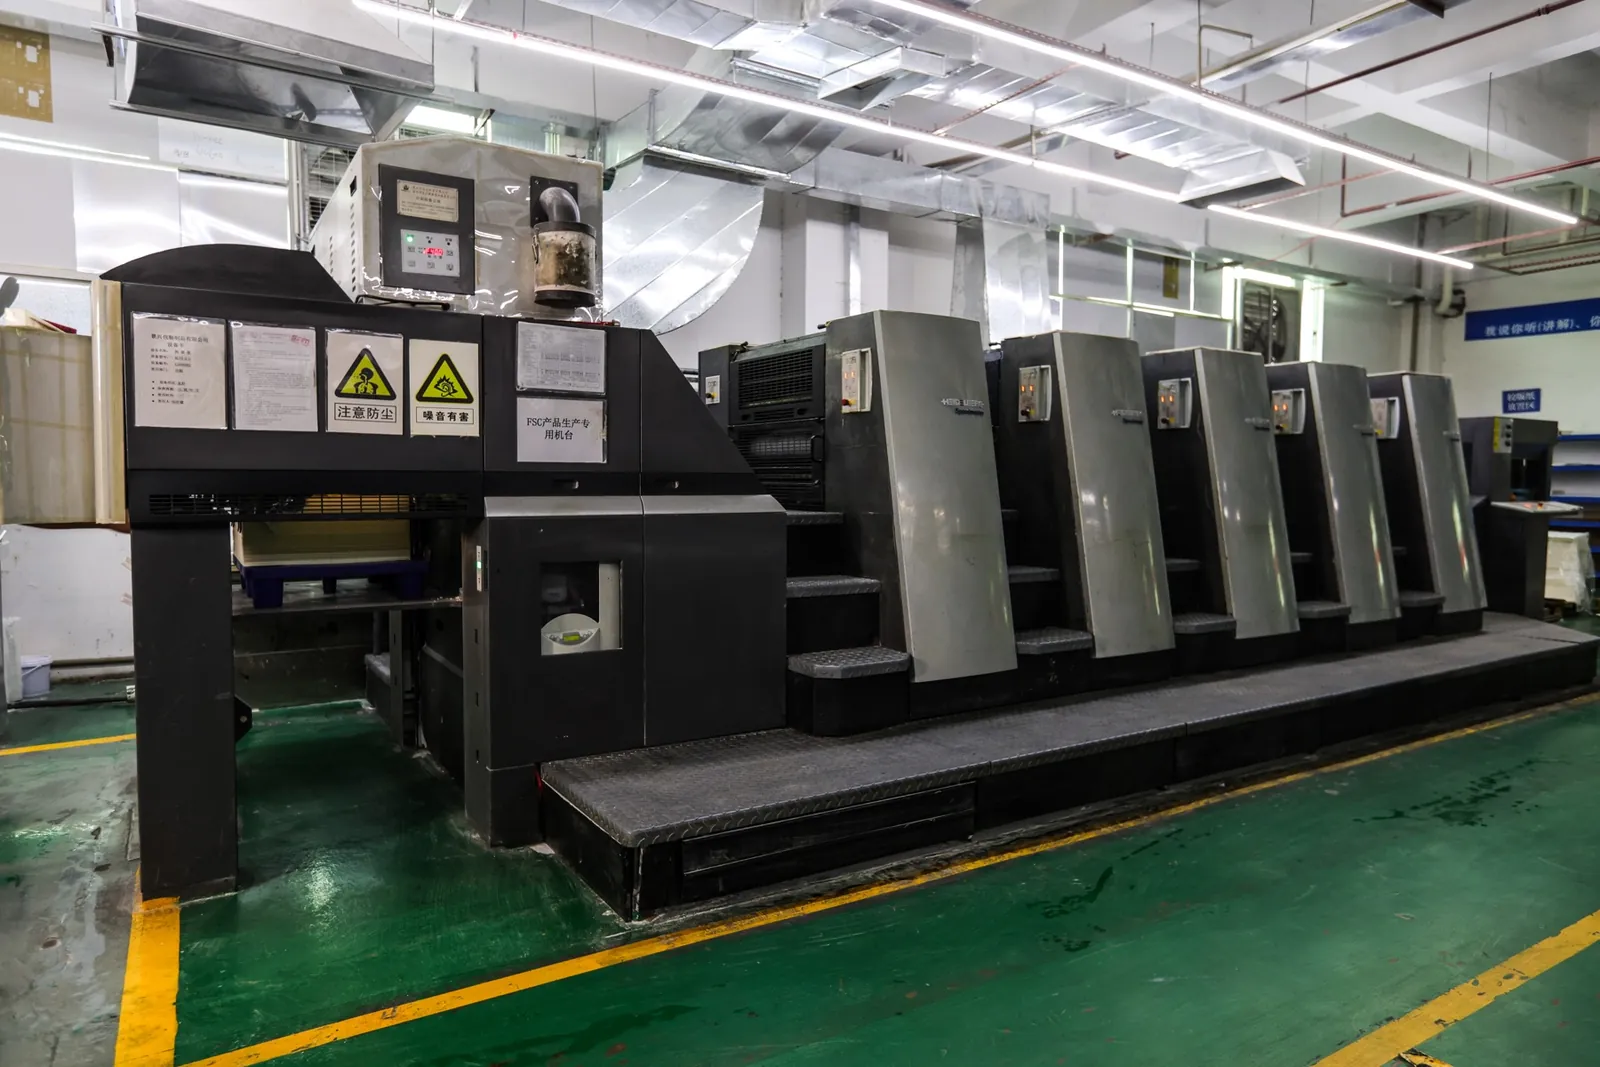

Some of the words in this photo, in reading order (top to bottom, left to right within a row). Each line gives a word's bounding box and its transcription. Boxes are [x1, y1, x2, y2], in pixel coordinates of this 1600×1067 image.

[337, 405, 394, 420] 注意防尘
[422, 410, 470, 422] 噪音有害
[526, 417, 591, 428] FSC产品生产专
[545, 429, 573, 440] 用机台
